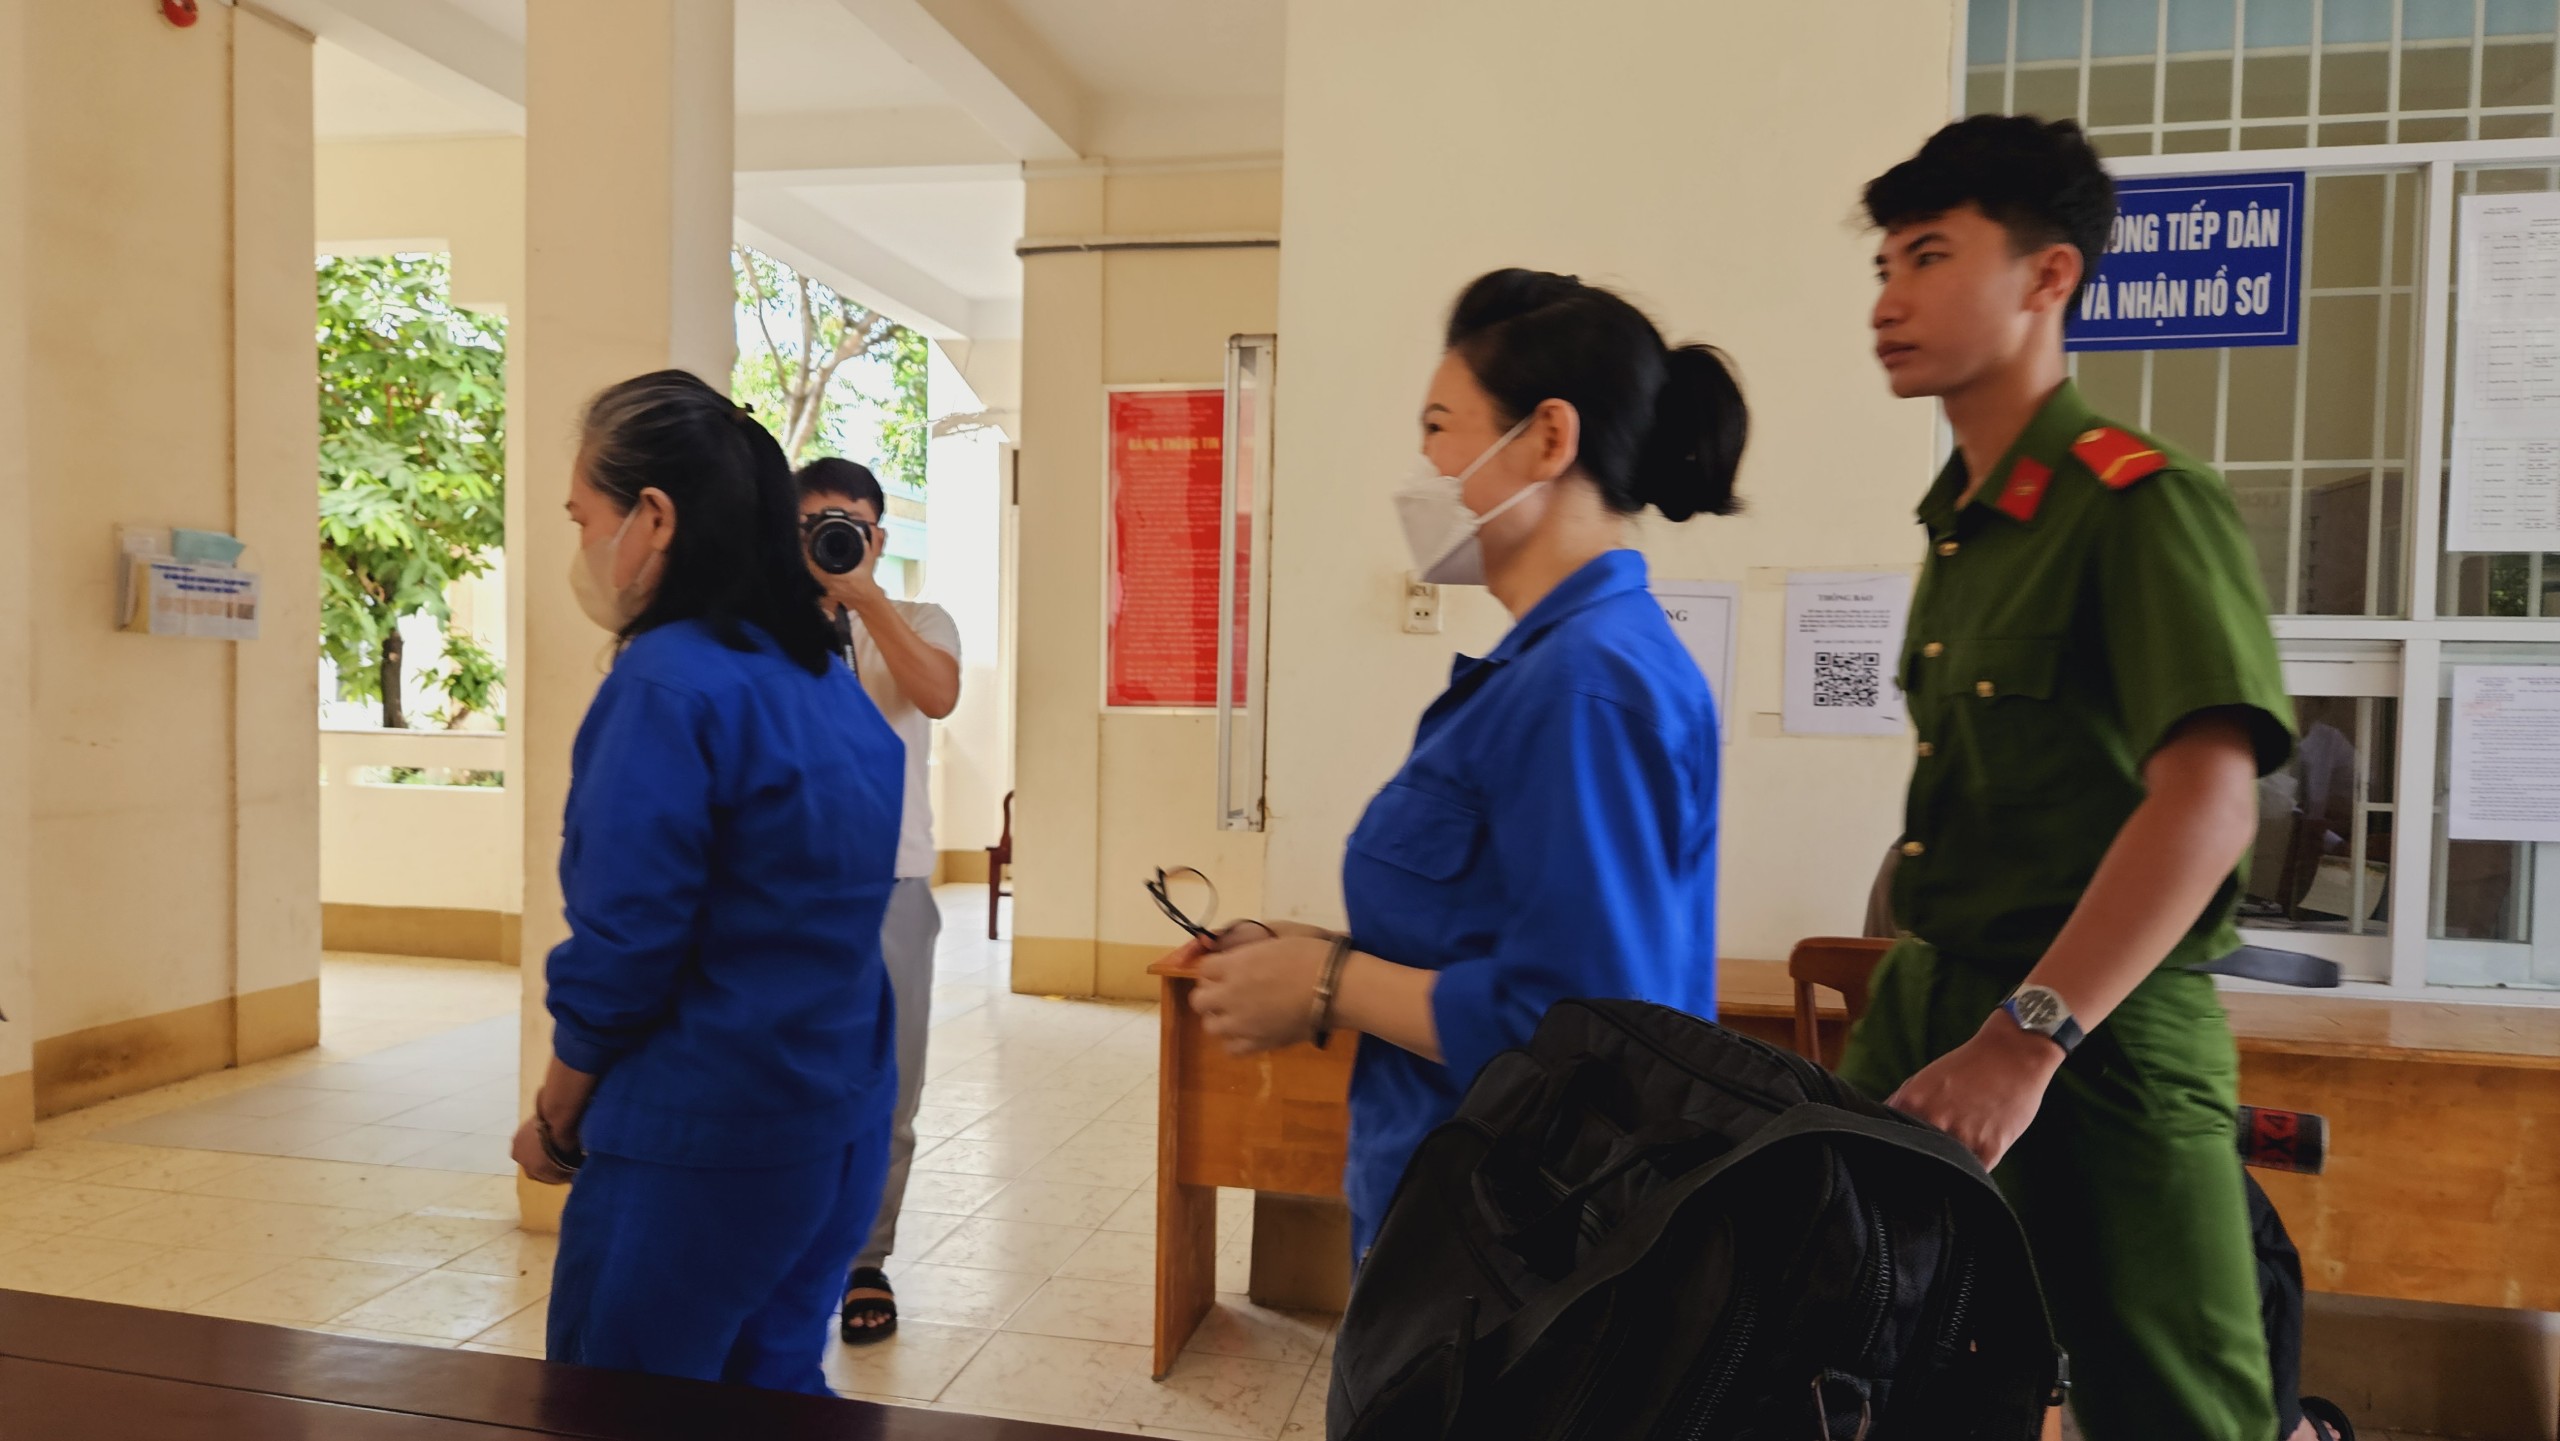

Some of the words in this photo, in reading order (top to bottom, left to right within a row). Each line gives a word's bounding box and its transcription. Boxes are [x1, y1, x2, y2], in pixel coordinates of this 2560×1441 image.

[2103, 207, 2160, 254] ÒNG
[2166, 199, 2220, 252] TIẾP
[2226, 201, 2280, 249] DÂN
[2081, 274, 2112, 321] VÀ
[2117, 272, 2188, 327] NHẬN
[2193, 265, 2229, 317] HỒ
[2235, 272, 2272, 316] SƠ
